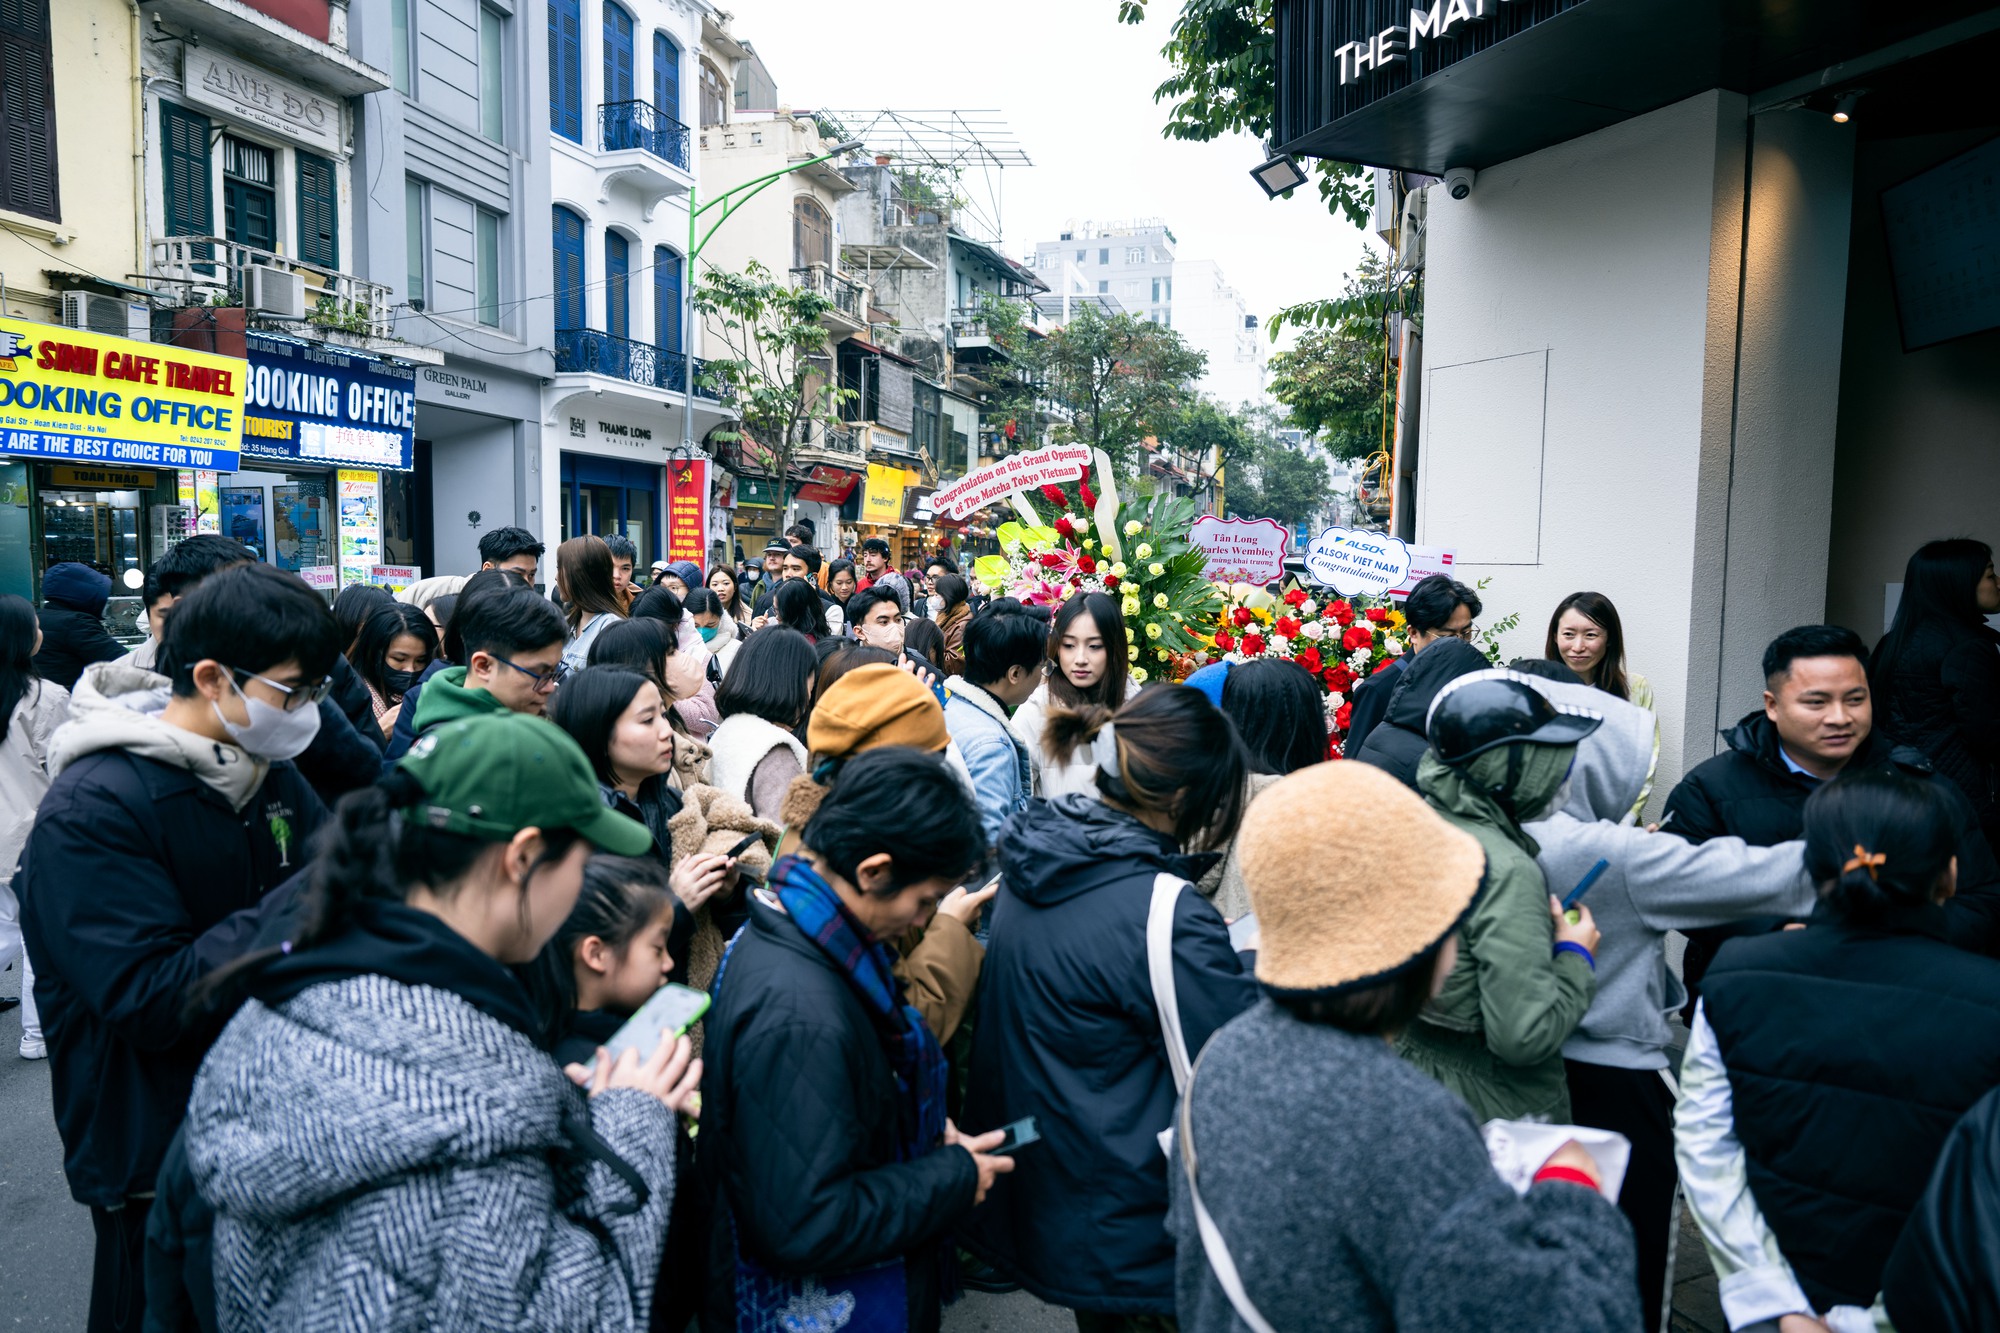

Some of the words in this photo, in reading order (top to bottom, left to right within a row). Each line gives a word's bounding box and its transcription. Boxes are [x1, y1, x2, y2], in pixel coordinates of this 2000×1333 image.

[1334, 26, 1401, 86] THE
[202, 62, 274, 109] ANH
[259, 340, 277, 355] LOCAL
[278, 343, 293, 358] TOUR
[37, 340, 99, 377] SINH
[103, 351, 160, 386] CAFE
[164, 360, 235, 397] TRAVEL
[424, 368, 459, 388] GREEN
[461, 377, 487, 394] PALM
[245, 364, 339, 418] BOOKING
[348, 382, 414, 429] OFFICE
[445, 389, 472, 401] GALLERY
[131, 397, 233, 432] OFFICE
[34, 419, 51, 428] Hoan
[51, 420, 68, 429] Kiem
[69, 422, 82, 431] Dist
[87, 424, 96, 432] Ha
[96, 425, 107, 433] Noi
[244, 415, 294, 440] TOURIST
[598, 421, 628, 436] THANG
[630, 427, 652, 440] LONG
[180, 434, 189, 443] Tel:
[605, 437, 645, 448] GALLERY
[8, 432, 39, 450] ARE
[43, 435, 70, 453] THE
[73, 438, 110, 458] BEST
[112, 441, 160, 462] CHOICE
[163, 446, 186, 464] FOR
[190, 450, 213, 466] YOU
[251, 444, 260, 452] 35
[260, 445, 278, 456] Hang
[278, 446, 290, 455] Gai
[933, 471, 995, 509] Congratulation
[995, 465, 1007, 477] on
[1007, 459, 1023, 472] the
[1022, 451, 1051, 467] Grand
[1051, 448, 1089, 462] Opening
[955, 502, 965, 516] of
[964, 495, 981, 509] The
[981, 483, 1011, 500] Matcha
[1011, 473, 1040, 489] Tokyo
[1040, 466, 1078, 479] Vietnam
[1213, 533, 1231, 542] Tân
[1234, 534, 1259, 546] Long
[1345, 539, 1387, 556] ALSOK
[1201, 545, 1229, 555] harles
[1232, 546, 1276, 559] Wembley
[1211, 557, 1232, 565] mừng
[1233, 557, 1248, 565] khai
[1317, 546, 1349, 561] ALSOK
[1352, 554, 1372, 568] VIET
[1375, 561, 1400, 575] NAM
[316, 574, 334, 584] SIM
[373, 567, 389, 576] MONEY
[389, 568, 413, 578] EXCHANGE
[1310, 556, 1391, 585] Congratulations
